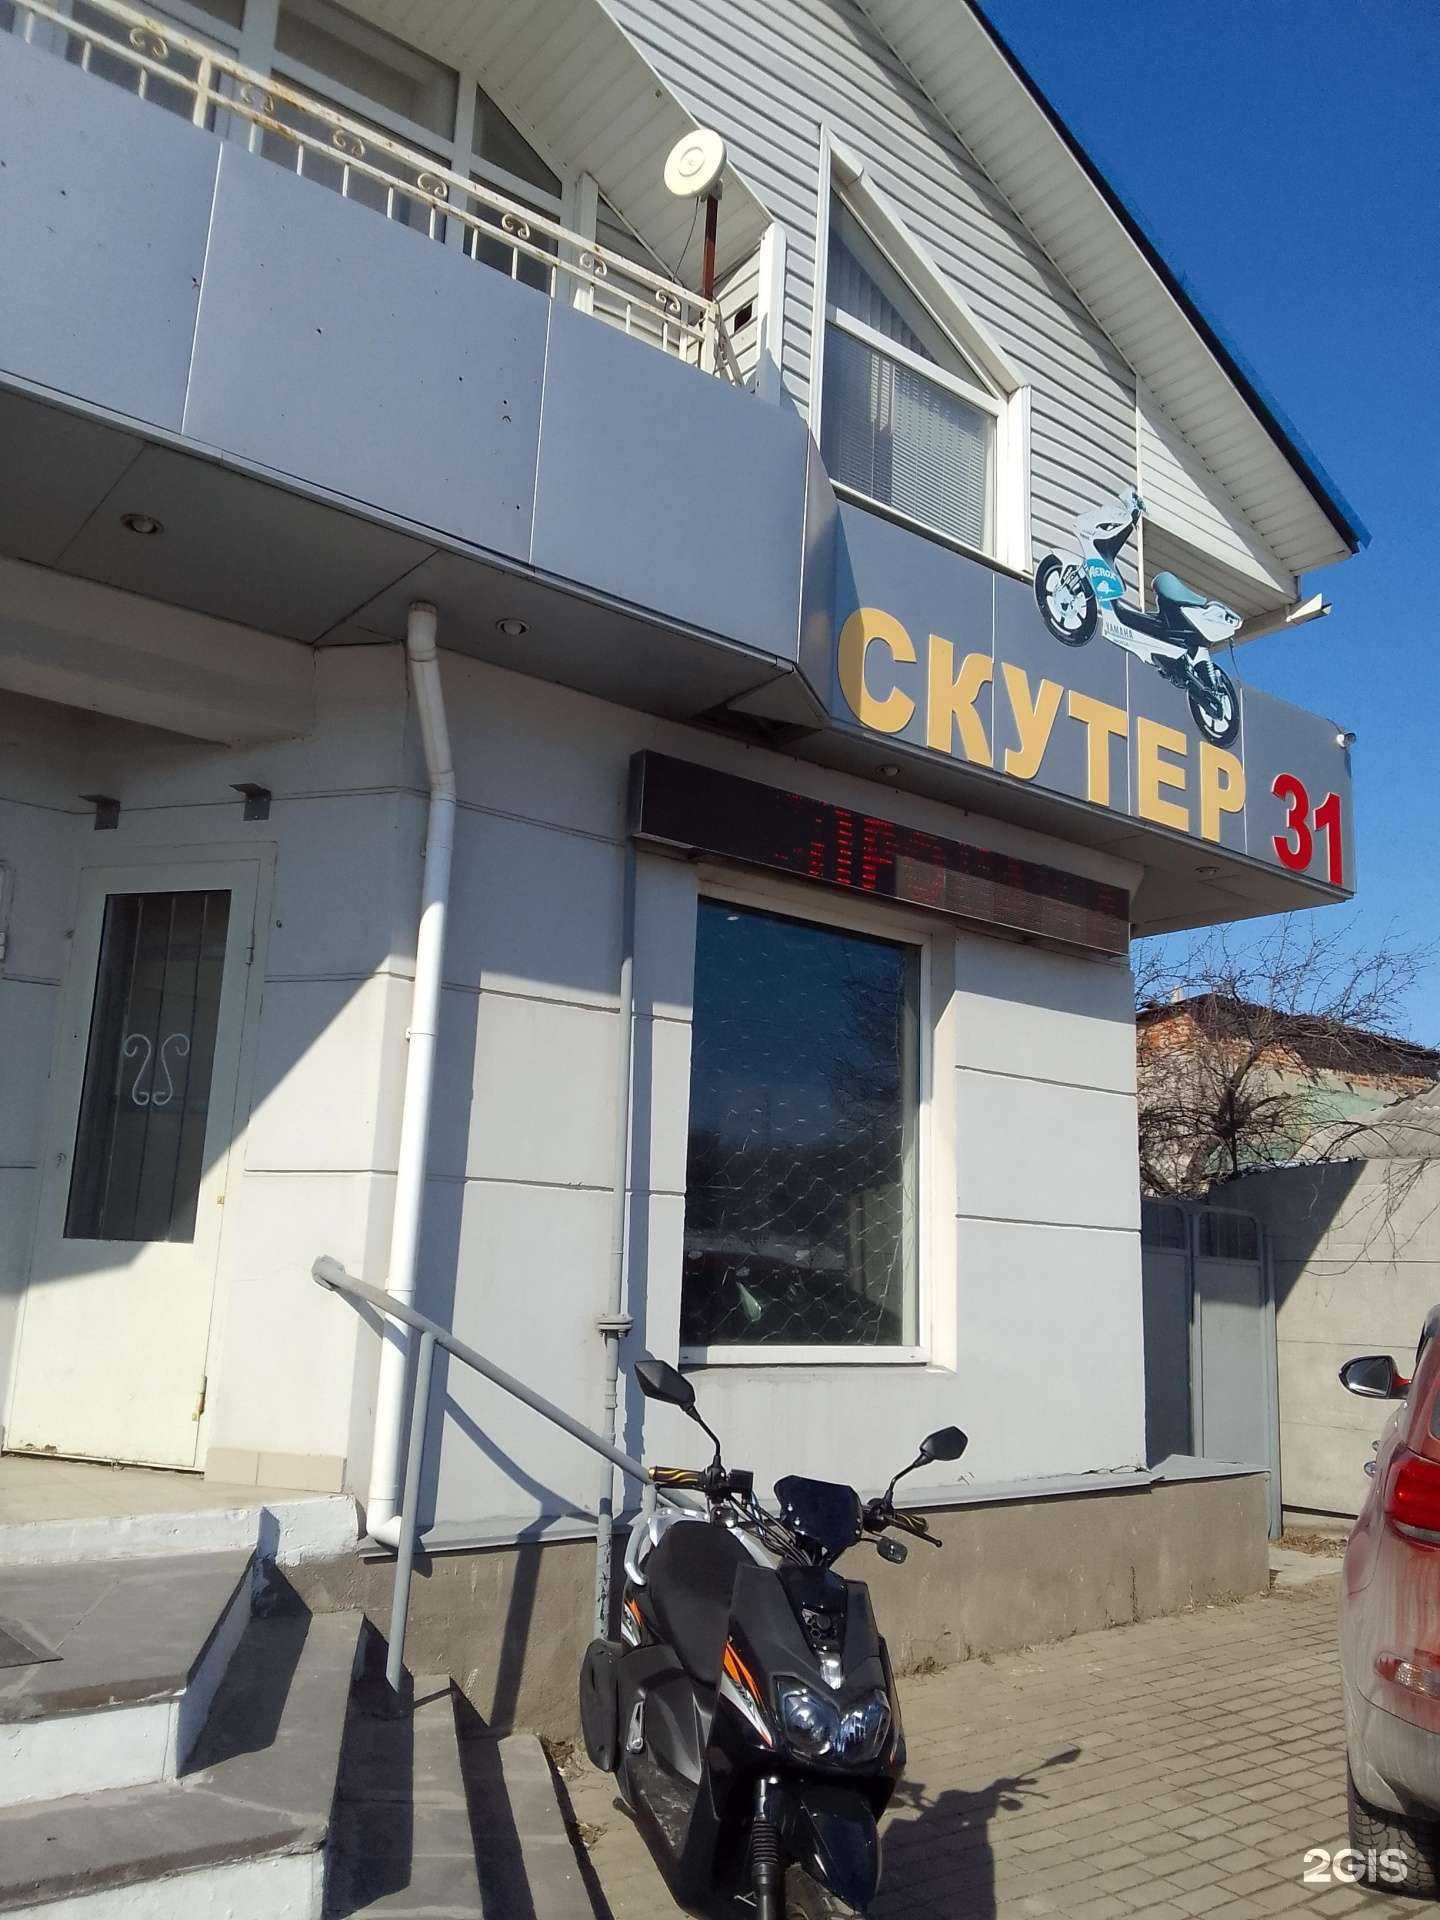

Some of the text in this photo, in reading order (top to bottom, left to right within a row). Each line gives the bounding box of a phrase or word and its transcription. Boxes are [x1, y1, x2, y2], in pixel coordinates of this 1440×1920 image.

[1105, 621, 1134, 639] YAMAHA
[838, 607, 1343, 886] СКУТЕР 31
